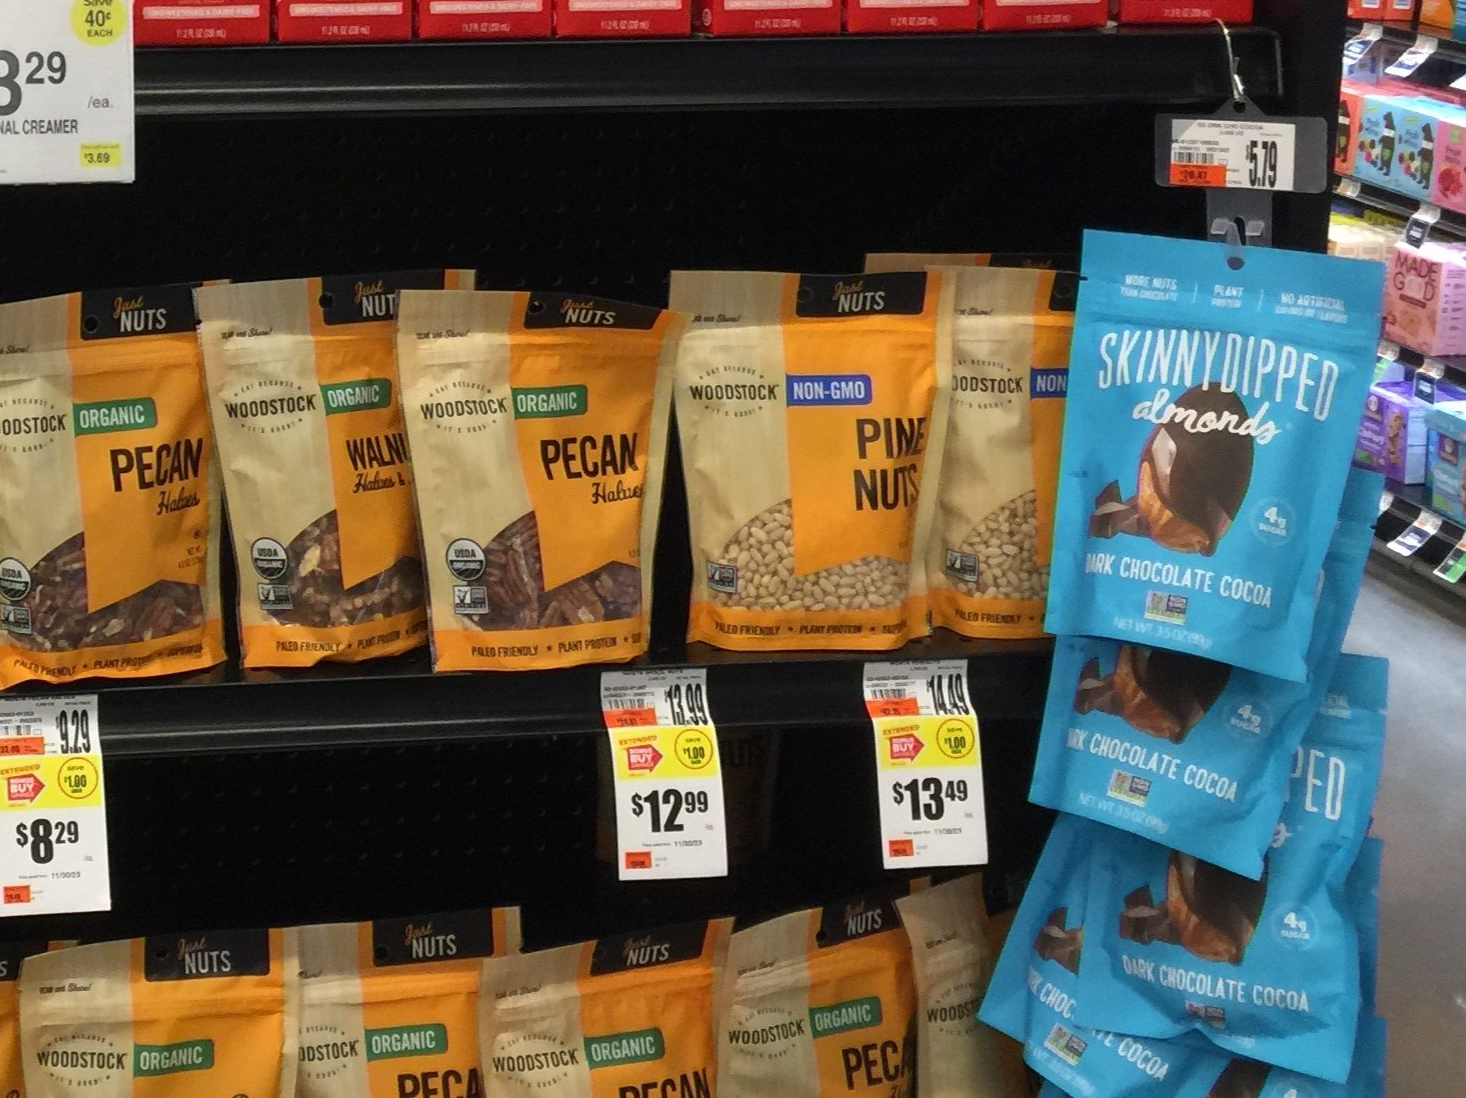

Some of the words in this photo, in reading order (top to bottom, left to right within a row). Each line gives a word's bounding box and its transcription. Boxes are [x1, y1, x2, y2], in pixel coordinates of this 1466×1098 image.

[87, 29, 112, 37] EACH
[22, 120, 78, 134] CREAMER
[837, 292, 885, 313] NUTS
[120, 308, 167, 332] NUTS
[564, 308, 616, 325] NUTS
[1099, 329, 1339, 421] SKINNYDIPPED
[225, 394, 316, 418] WOODSTOCK
[327, 384, 379, 407] ORGANIC
[689, 384, 779, 401] WOODSTOCK
[792, 381, 865, 400] NON-GMO
[79, 403, 145, 429] ORGANIC
[420, 397, 508, 419] WOODSTOCK
[517, 392, 577, 412] ORGANIC
[1132, 388, 1282, 445] almonds
[856, 417, 924, 460] PINE
[109, 438, 203, 492] PECAN
[540, 432, 638, 480] PECAN
[854, 464, 919, 511] NUTS
[1120, 556, 1212, 592] CHOCOLATE
[1219, 574, 1273, 609] COCOA
[630, 754, 652, 763] BUY
[412, 935, 458, 958] NUTS
[185, 951, 232, 974] NUTS
[1122, 954, 1155, 983] DARK
[1159, 964, 1245, 1001] CHOCOLATE
[1252, 984, 1309, 1012] COCOA
[728, 1019, 804, 1044] WOODSTOCK
[815, 1004, 871, 1029] ORGANIC
[371, 1031, 436, 1053] ORGANIC
[492, 1049, 579, 1073] WOODSTOCK
[591, 1037, 656, 1062] ORGANIC
[37, 1051, 126, 1070] WOODSTOCK
[140, 1048, 203, 1070] ORGANIC
